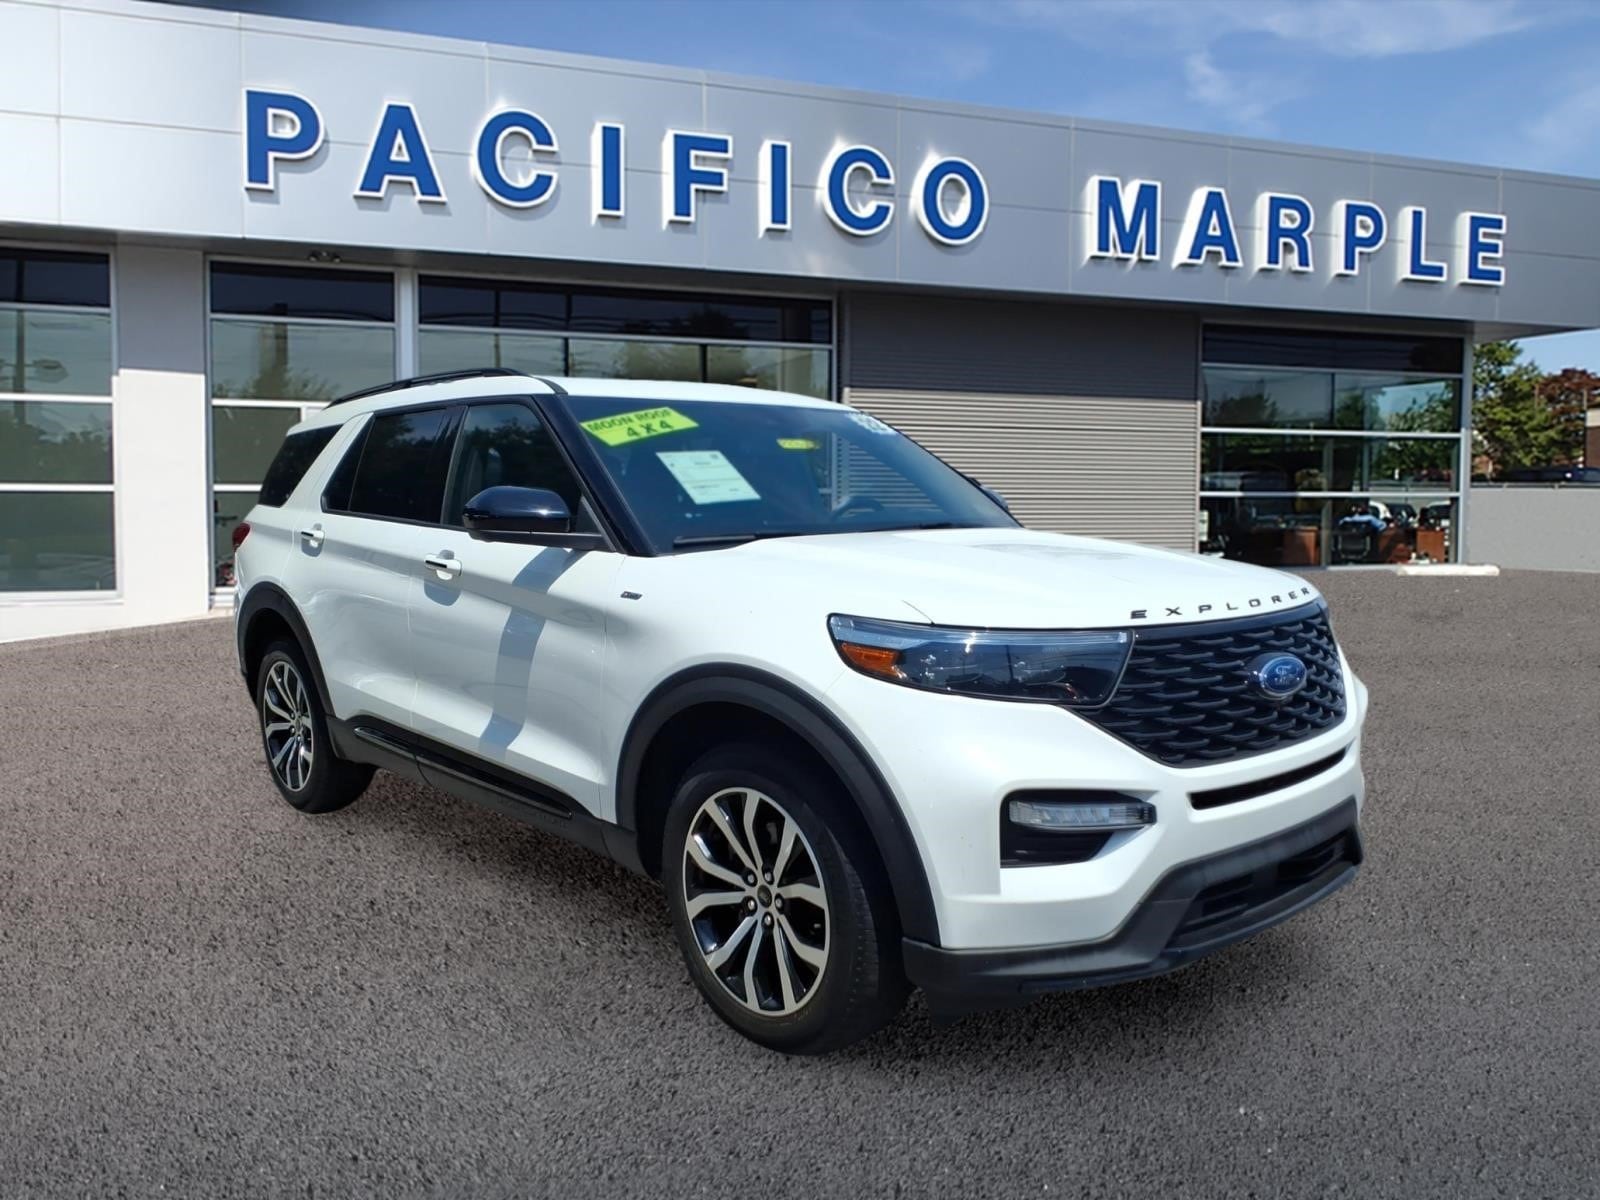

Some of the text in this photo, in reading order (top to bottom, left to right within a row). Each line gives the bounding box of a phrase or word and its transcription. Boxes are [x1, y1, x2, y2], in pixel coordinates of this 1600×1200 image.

[243, 88, 1506, 286] PACIFICO MARPLE
[1130, 587, 1311, 620] EXPLORER
